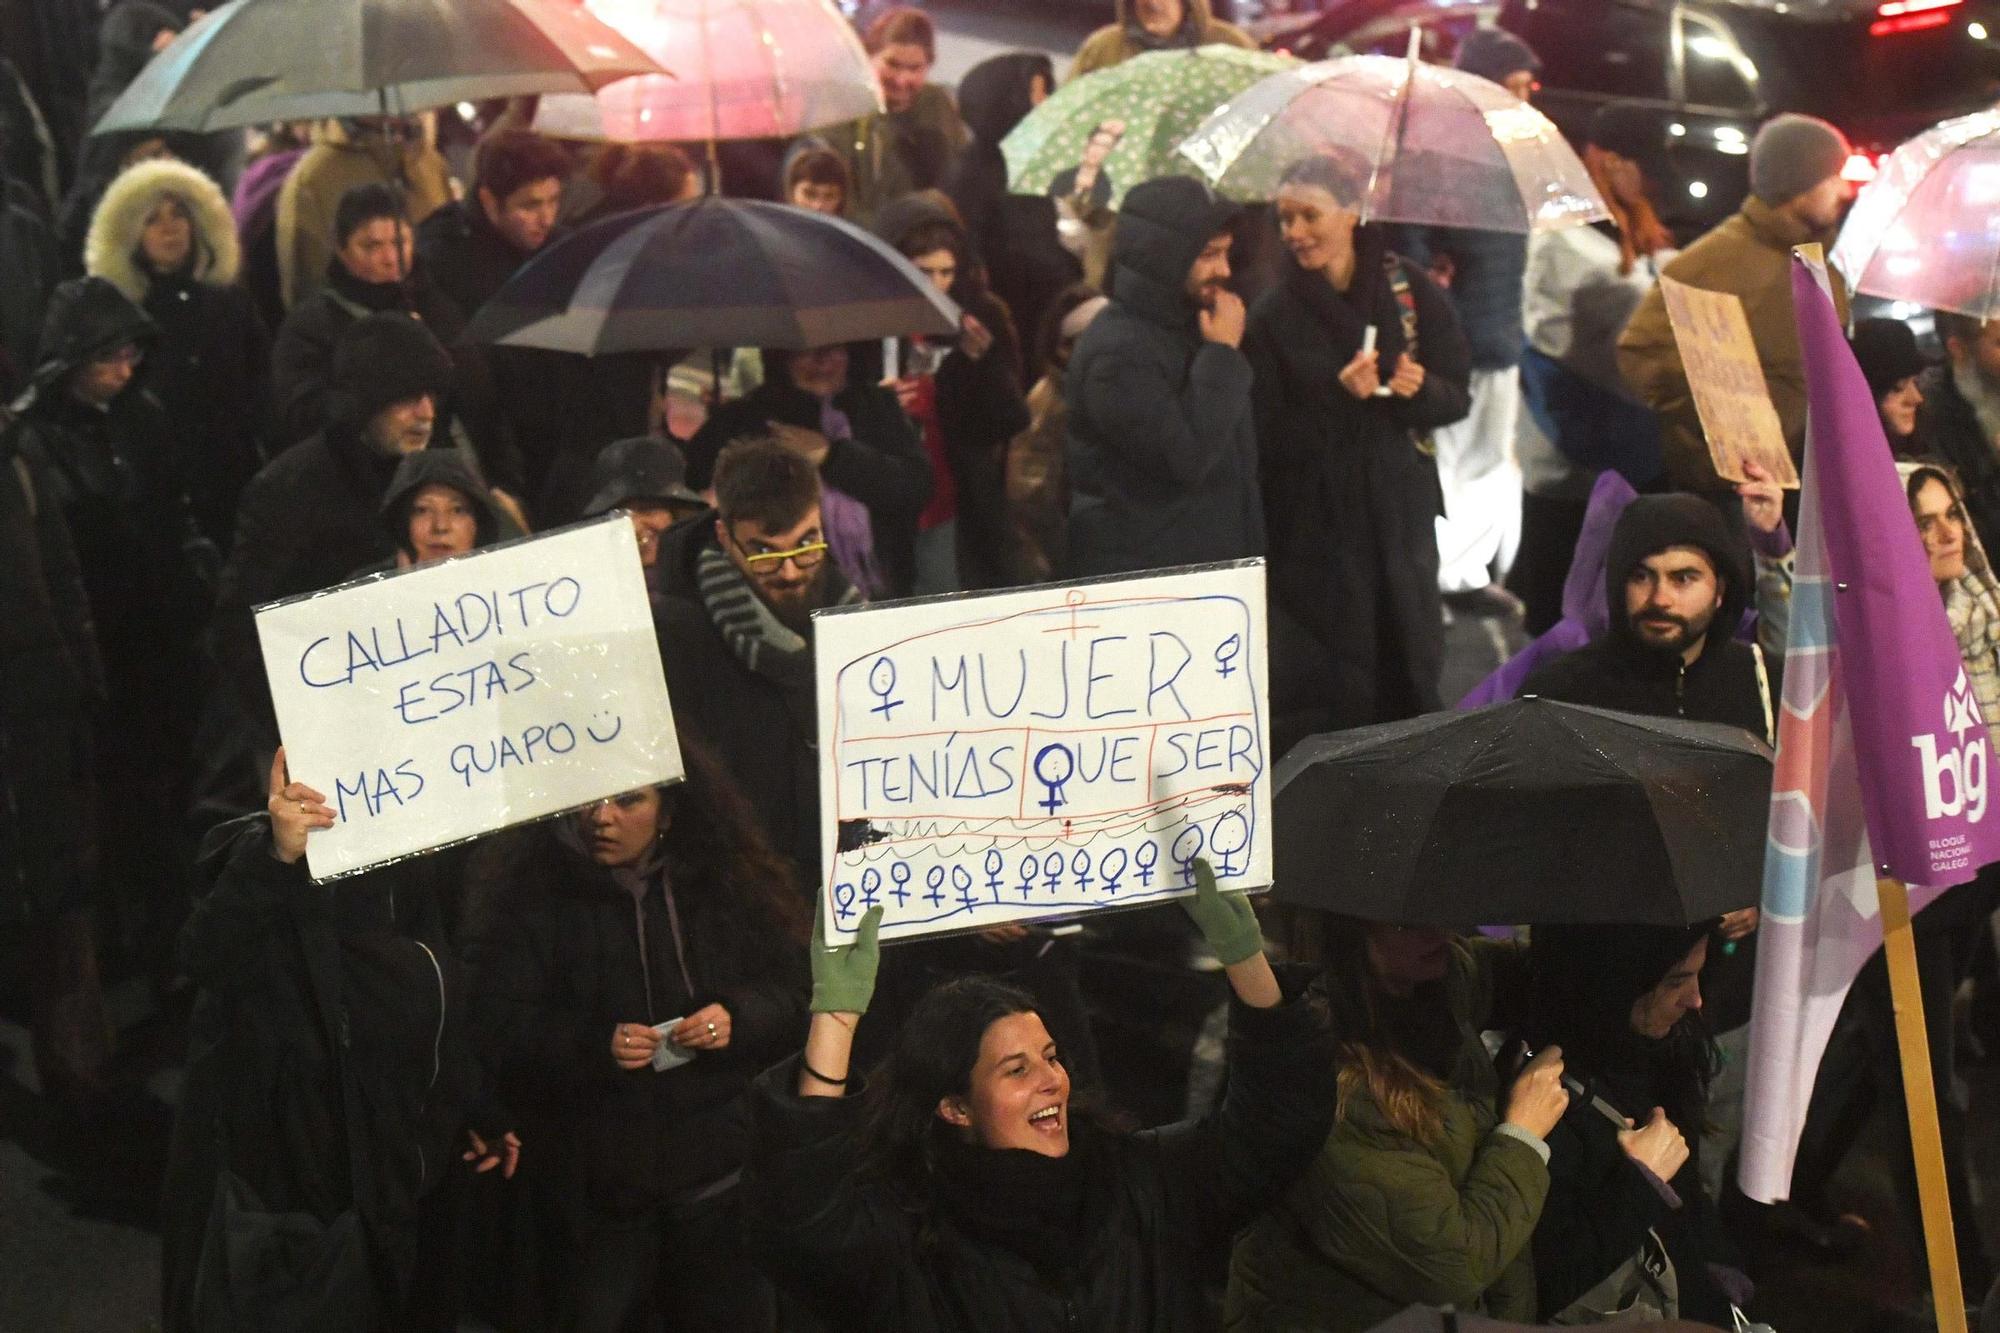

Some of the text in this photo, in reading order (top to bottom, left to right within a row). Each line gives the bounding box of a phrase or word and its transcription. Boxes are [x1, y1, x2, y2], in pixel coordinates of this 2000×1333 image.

[300, 576, 581, 688] CALLADITO
[932, 631, 1192, 721] MUJER
[393, 652, 537, 724] ESTAS
[335, 721, 577, 822] MAS GUAPO
[846, 724, 1259, 816] TENÍAS QUE SER
